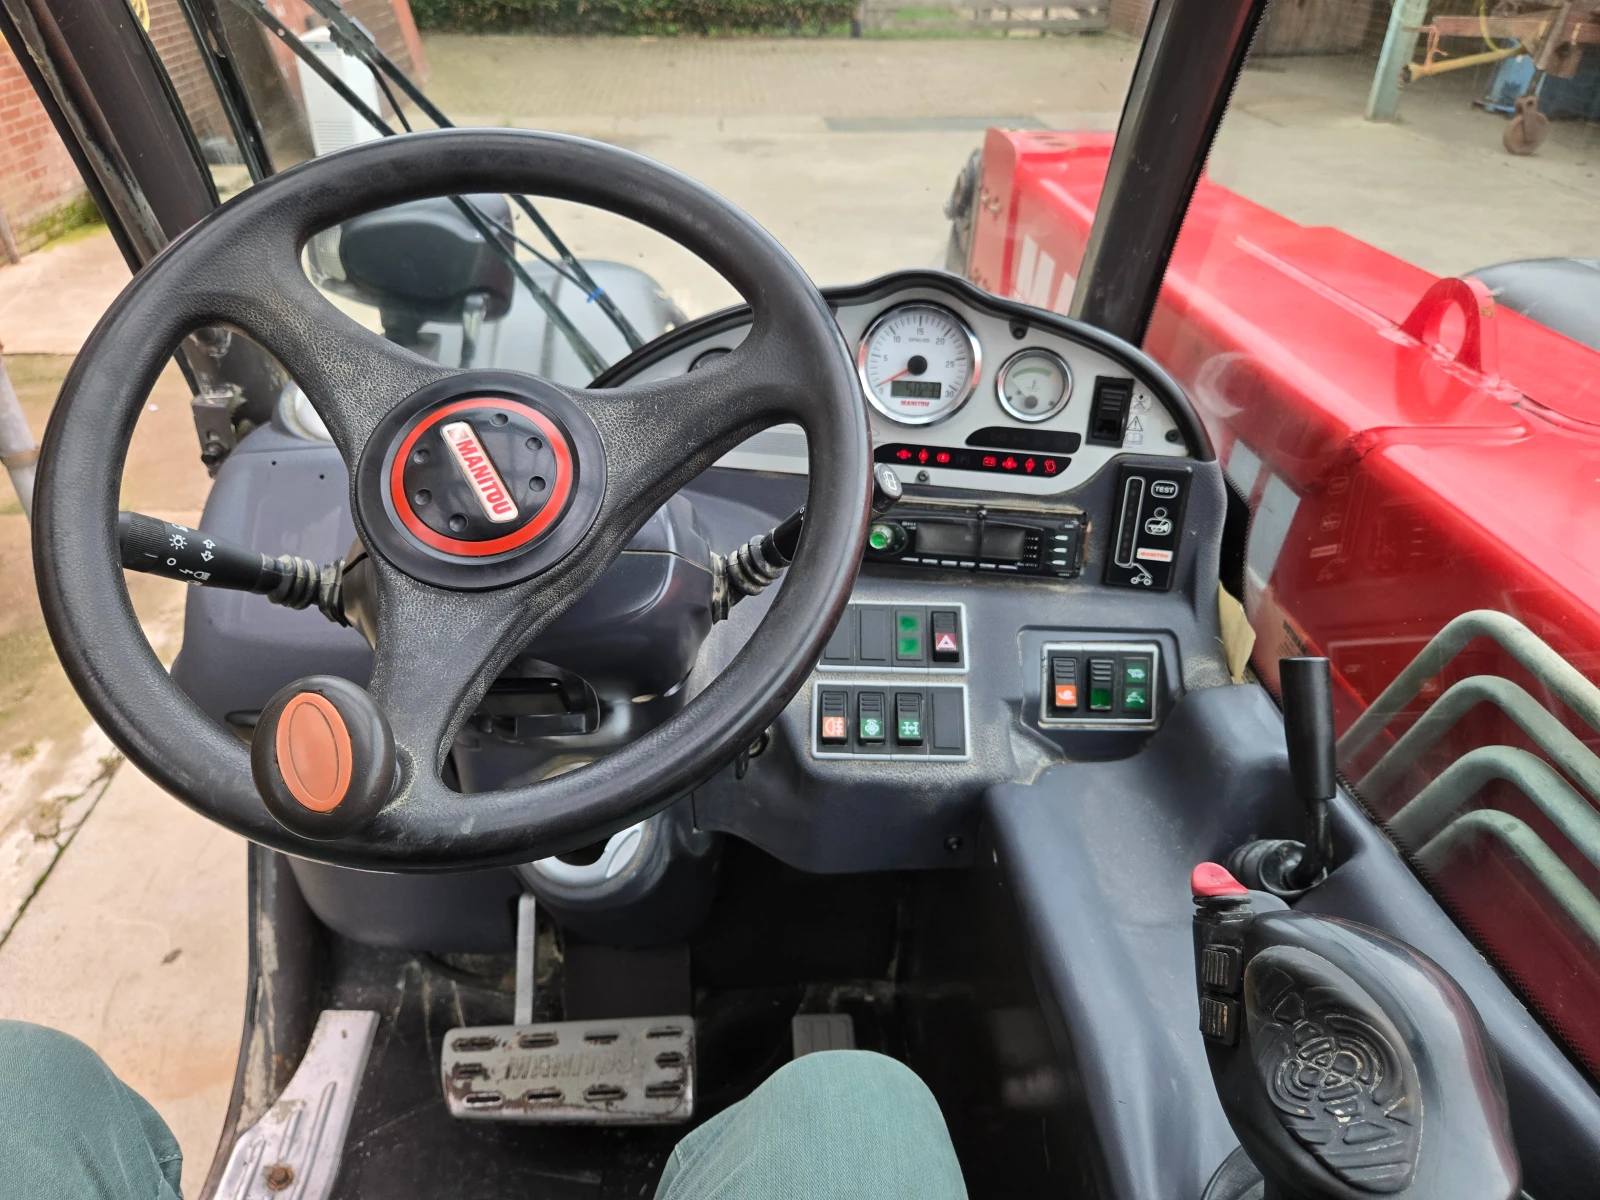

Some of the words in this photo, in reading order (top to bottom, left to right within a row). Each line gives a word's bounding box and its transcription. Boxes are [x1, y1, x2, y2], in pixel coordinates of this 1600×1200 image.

[916, 328, 924, 336] 15
[893, 336, 901, 344] 10
[935, 337, 945, 346] 20
[945, 391, 954, 399] 30
[455, 439, 512, 515] MANITOU
[1154, 485, 1175, 494] TEST
